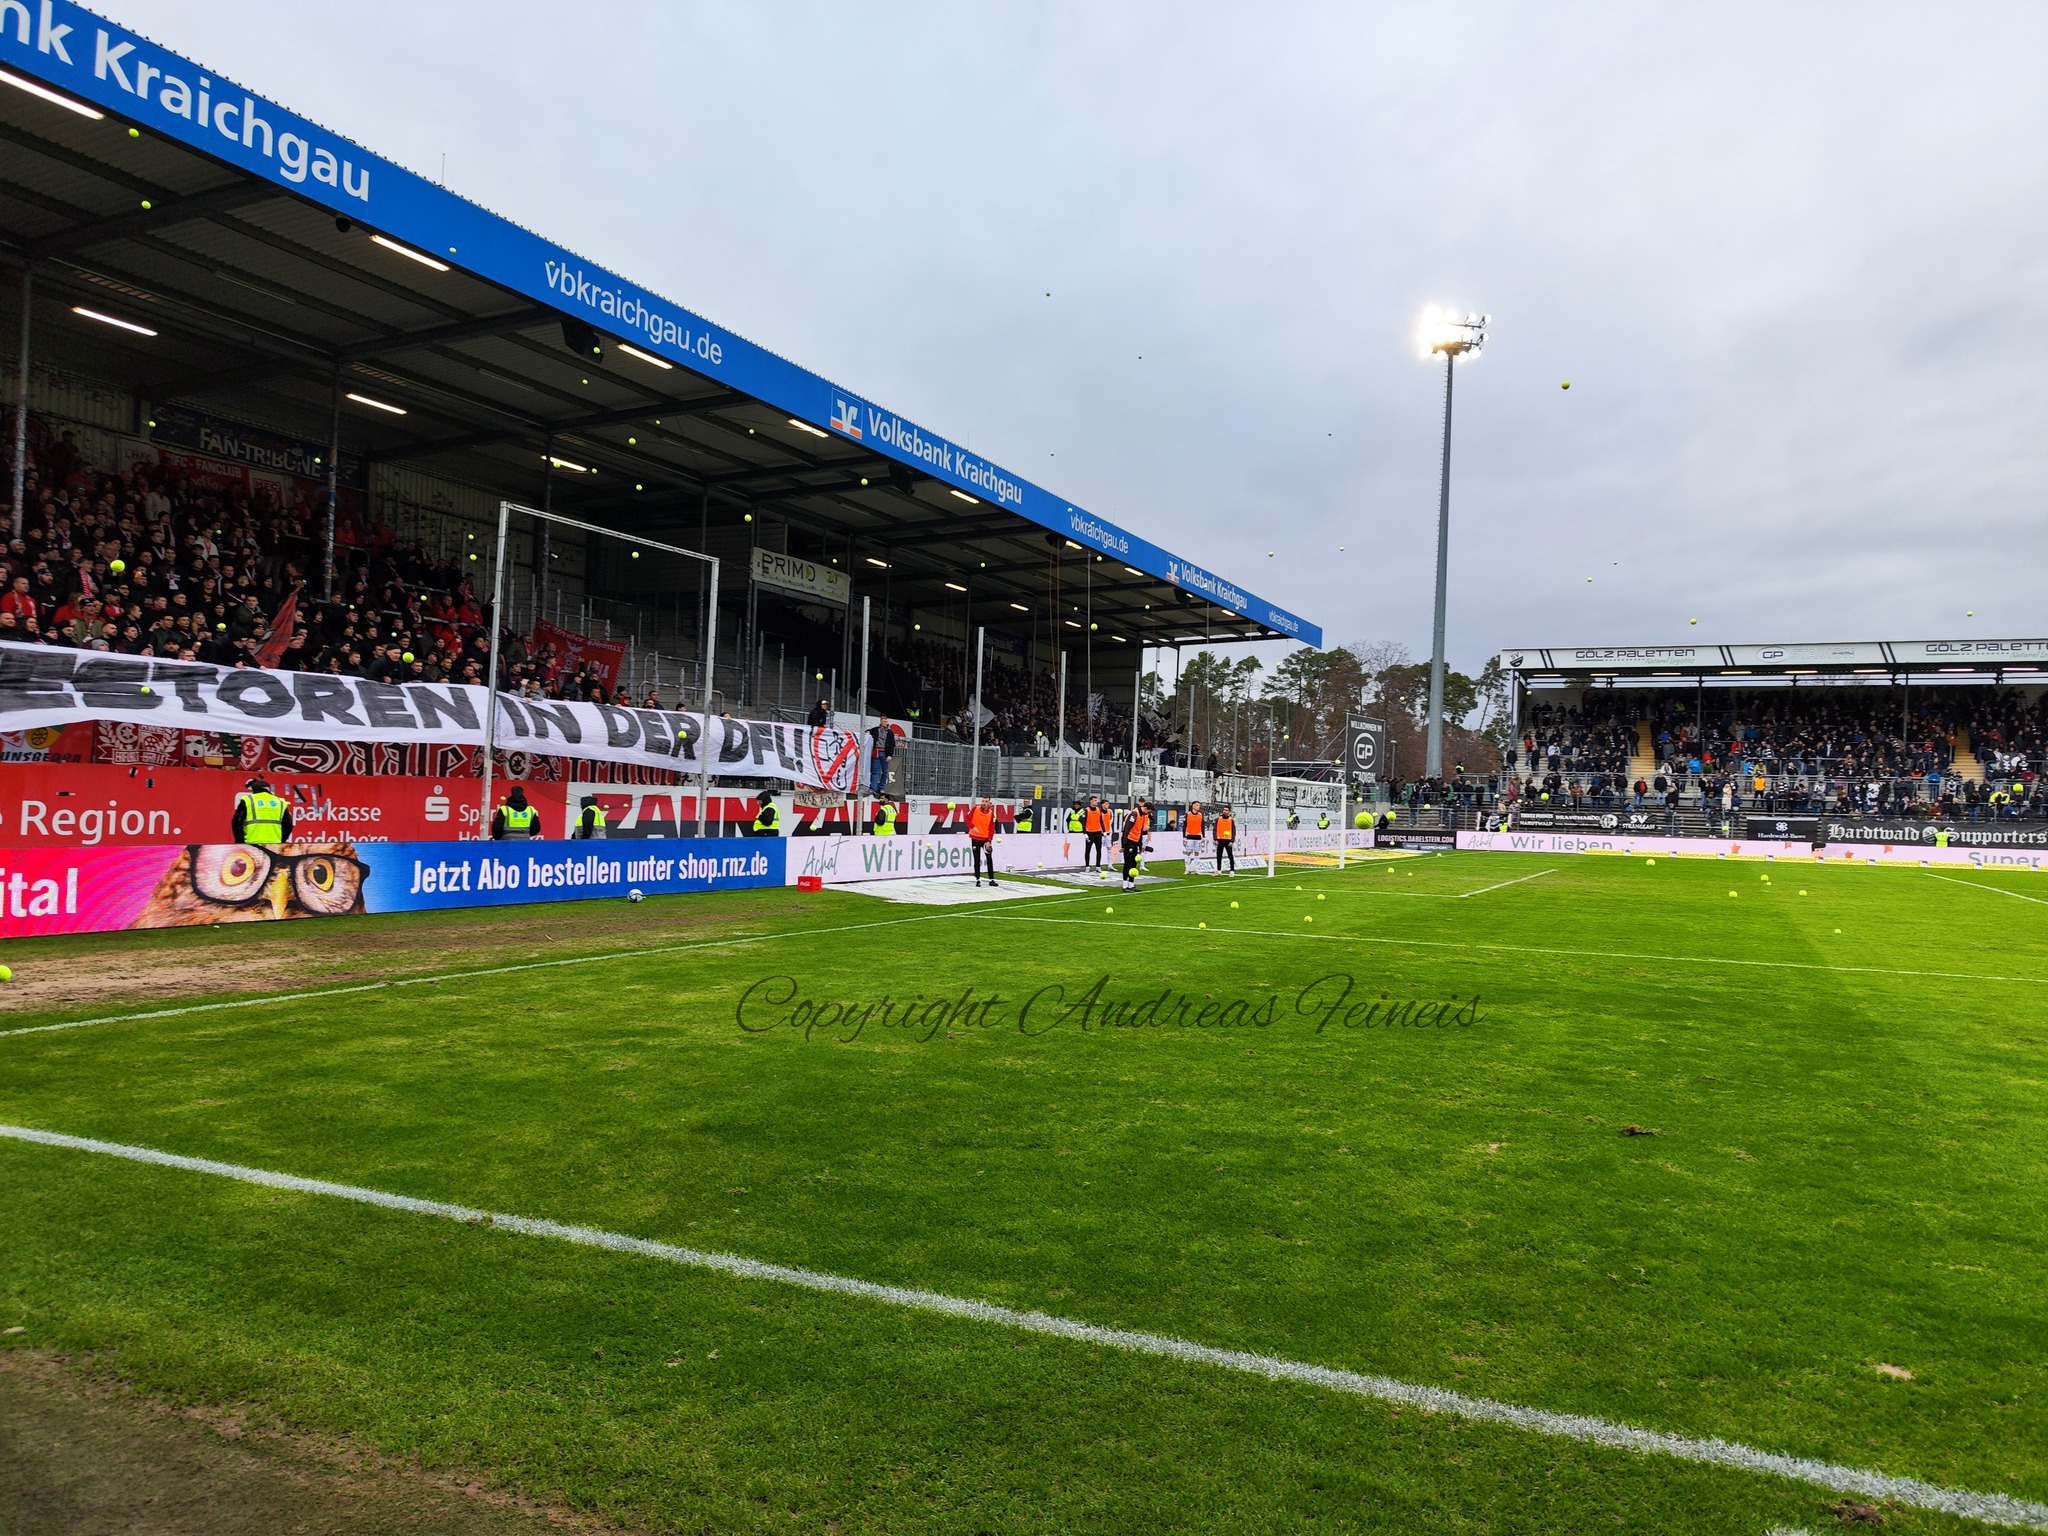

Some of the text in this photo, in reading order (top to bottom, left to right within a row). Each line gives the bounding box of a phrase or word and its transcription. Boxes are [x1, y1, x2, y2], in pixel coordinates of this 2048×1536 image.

[94, 29, 370, 202] Kraichgau
[545, 262, 723, 365] vbkraichgau.de
[868, 407, 1022, 505] Volksbank Kraichgau
[1070, 514, 1129, 555] vbkraichgau.de
[1181, 562, 1248, 610] Volksbank Kraichgau
[1575, 649, 1614, 659] GÖLZ
[1763, 651, 1783, 659] GP
[1926, 641, 1972, 652] GÖLZ
[499, 694, 582, 744] IN
[594, 703, 700, 760] DER
[719, 717, 804, 773] DFL!
[1356, 744, 1373, 759] GP
[21, 801, 182, 845] Region.
[290, 798, 382, 826] parkasse
[929, 803, 1014, 834] ZAN
[1629, 814, 1648, 824] SV
[1511, 835, 1544, 849] Wir
[1827, 823, 1920, 841] Hardtwald
[410, 851, 768, 894] Jetzt Abo bestellen unter shop.rnz.de
[802, 836, 850, 876] Achat
[862, 840, 903, 873] Wir
